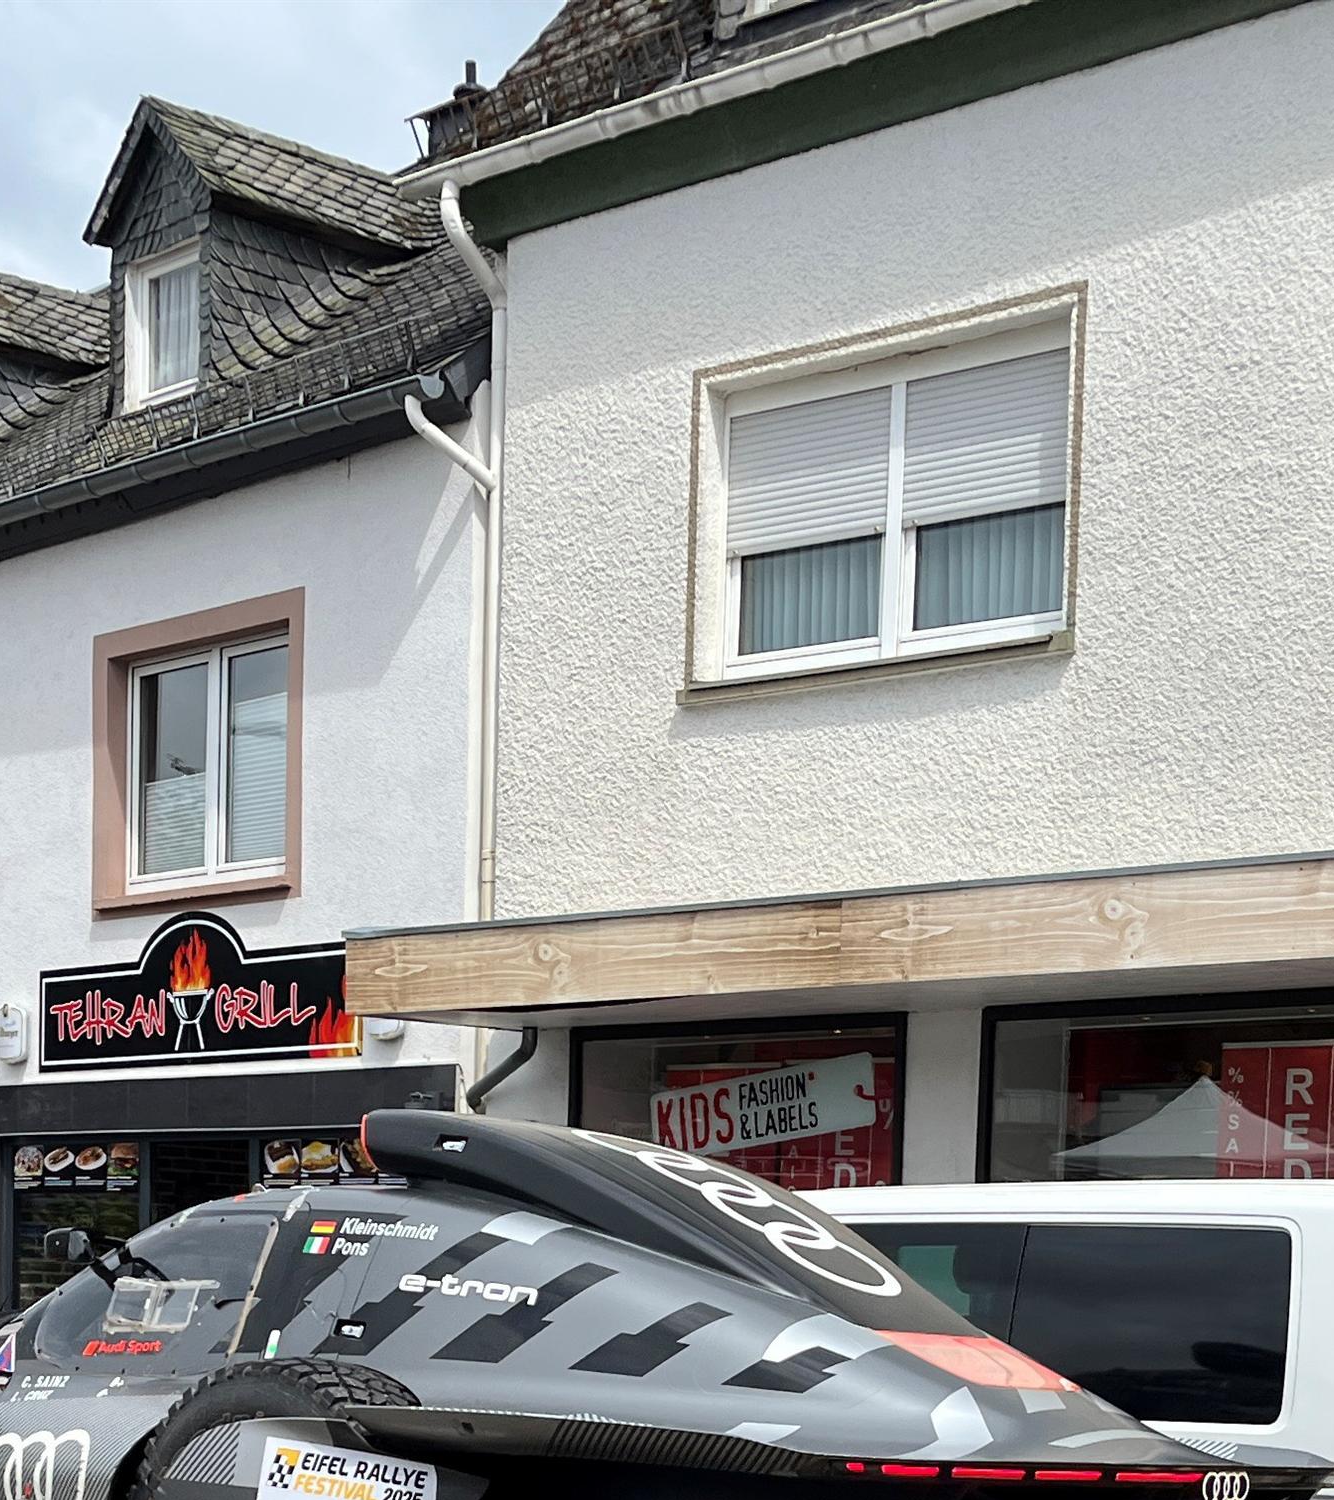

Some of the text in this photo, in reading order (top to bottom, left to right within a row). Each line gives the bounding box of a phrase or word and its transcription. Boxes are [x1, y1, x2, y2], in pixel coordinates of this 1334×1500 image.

[50, 980, 317, 1045] TEHRAN GRILL
[739, 1072, 806, 1110] FASHION
[656, 1087, 735, 1151] KIDS
[740, 1101, 818, 1140] &LABELS
[340, 1217, 439, 1241] Kleinschmidt
[332, 1237, 369, 1256] Pons
[398, 1274, 538, 1306] e-tron
[99, 1339, 162, 1354] Audi Sport
[21, 1376, 71, 1388] C. SAINZ
[301, 1453, 428, 1489] EIFEL RALLYE
